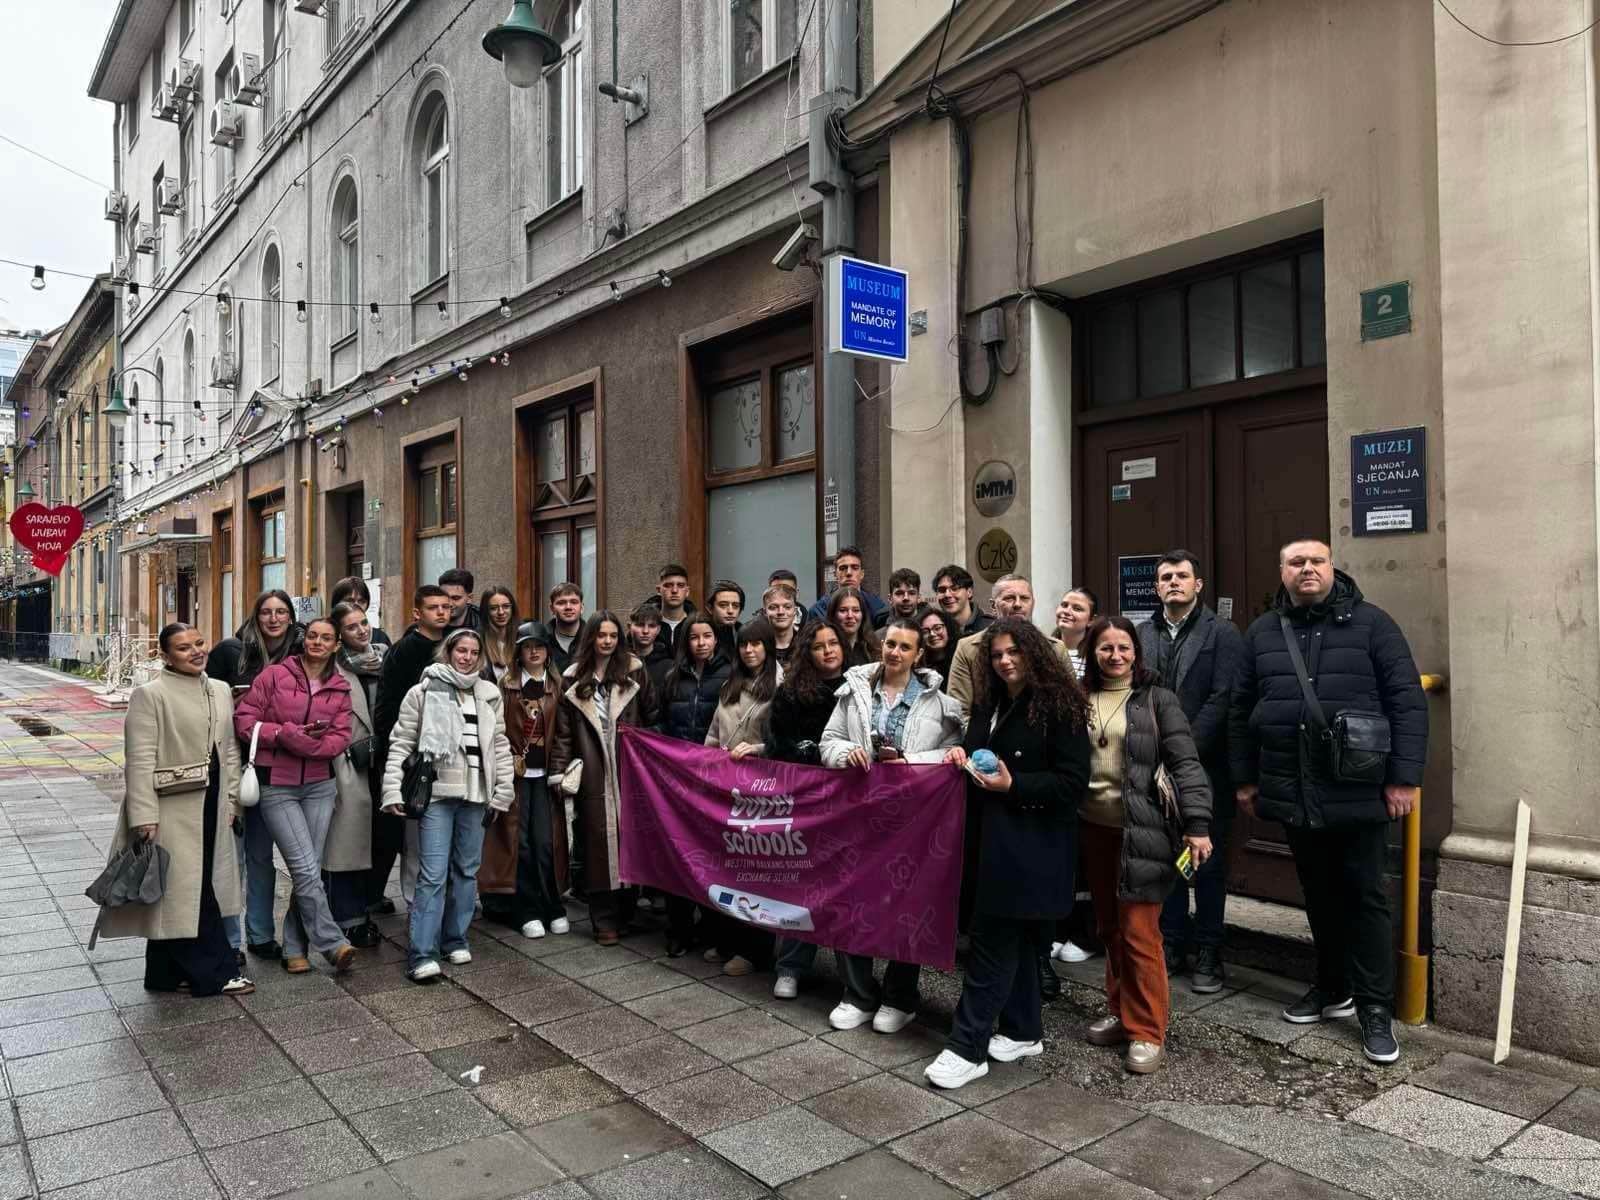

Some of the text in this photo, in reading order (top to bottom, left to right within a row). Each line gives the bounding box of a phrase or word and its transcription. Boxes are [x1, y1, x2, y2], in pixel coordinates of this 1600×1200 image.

[847, 275, 901, 300] MUSEUM
[851, 301, 897, 317] MANDATE OF
[1377, 294, 1393, 315] 2
[851, 311, 897, 329] MEMORY
[853, 330, 867, 340] UN
[1363, 439, 1413, 456] MUZEJ
[1370, 461, 1406, 471] MANDAT
[976, 479, 1013, 499] iMTM
[1365, 487, 1380, 496] UN
[25, 514, 71, 525] SARAJEVO
[37, 541, 62, 552] MOJA
[1126, 587, 1156, 596] MEMOR
[751, 777, 777, 791] RYCO
[722, 824, 808, 857] schools
